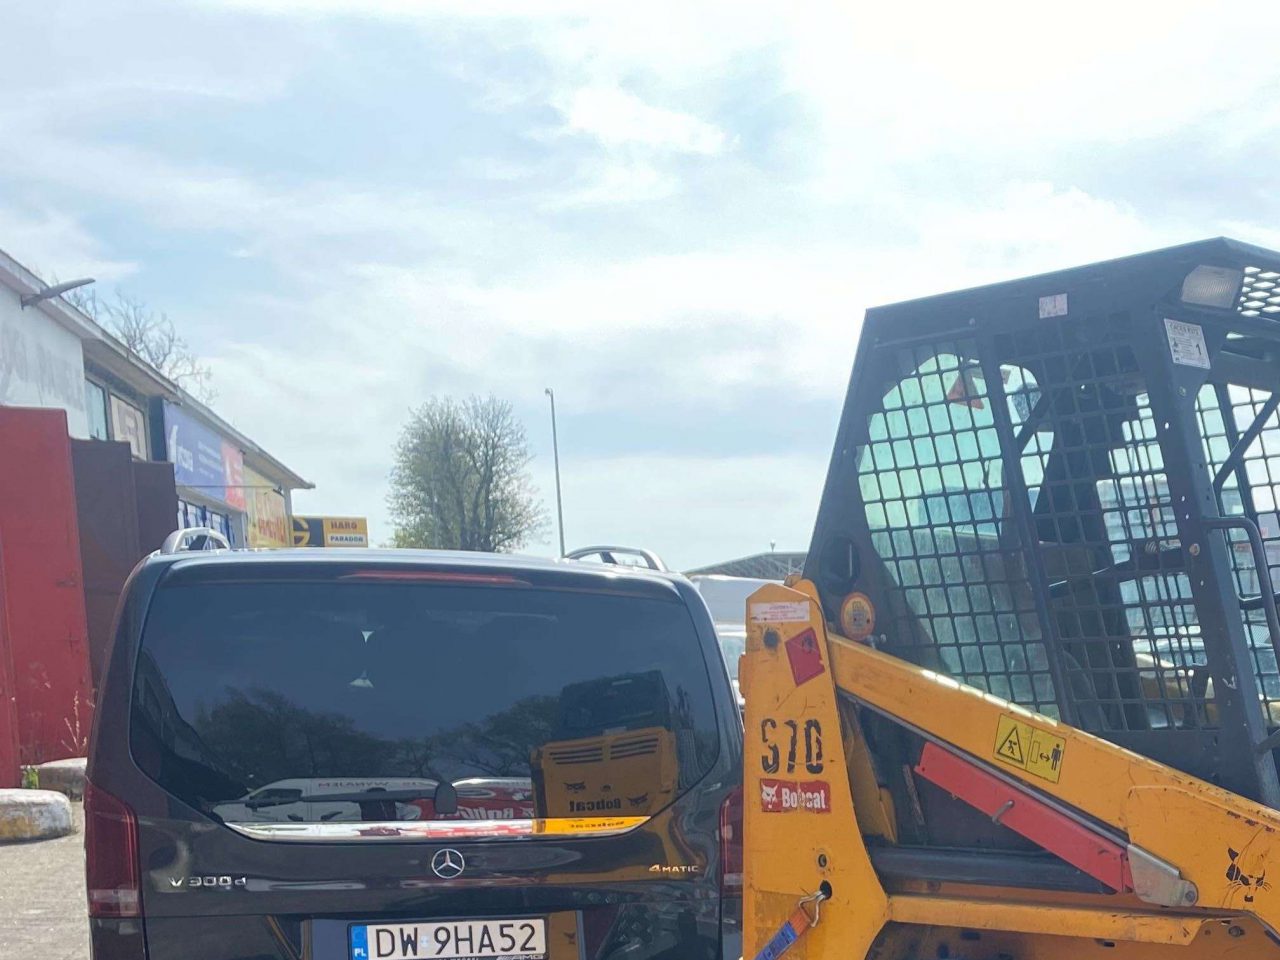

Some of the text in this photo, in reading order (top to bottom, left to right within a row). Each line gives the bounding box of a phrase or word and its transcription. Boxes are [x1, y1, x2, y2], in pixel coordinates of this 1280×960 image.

[781, 787, 826, 809] Bobcat
[168, 876, 184, 887] V
[375, 923, 537, 958] DW 9HA52
[354, 948, 367, 958] PL
